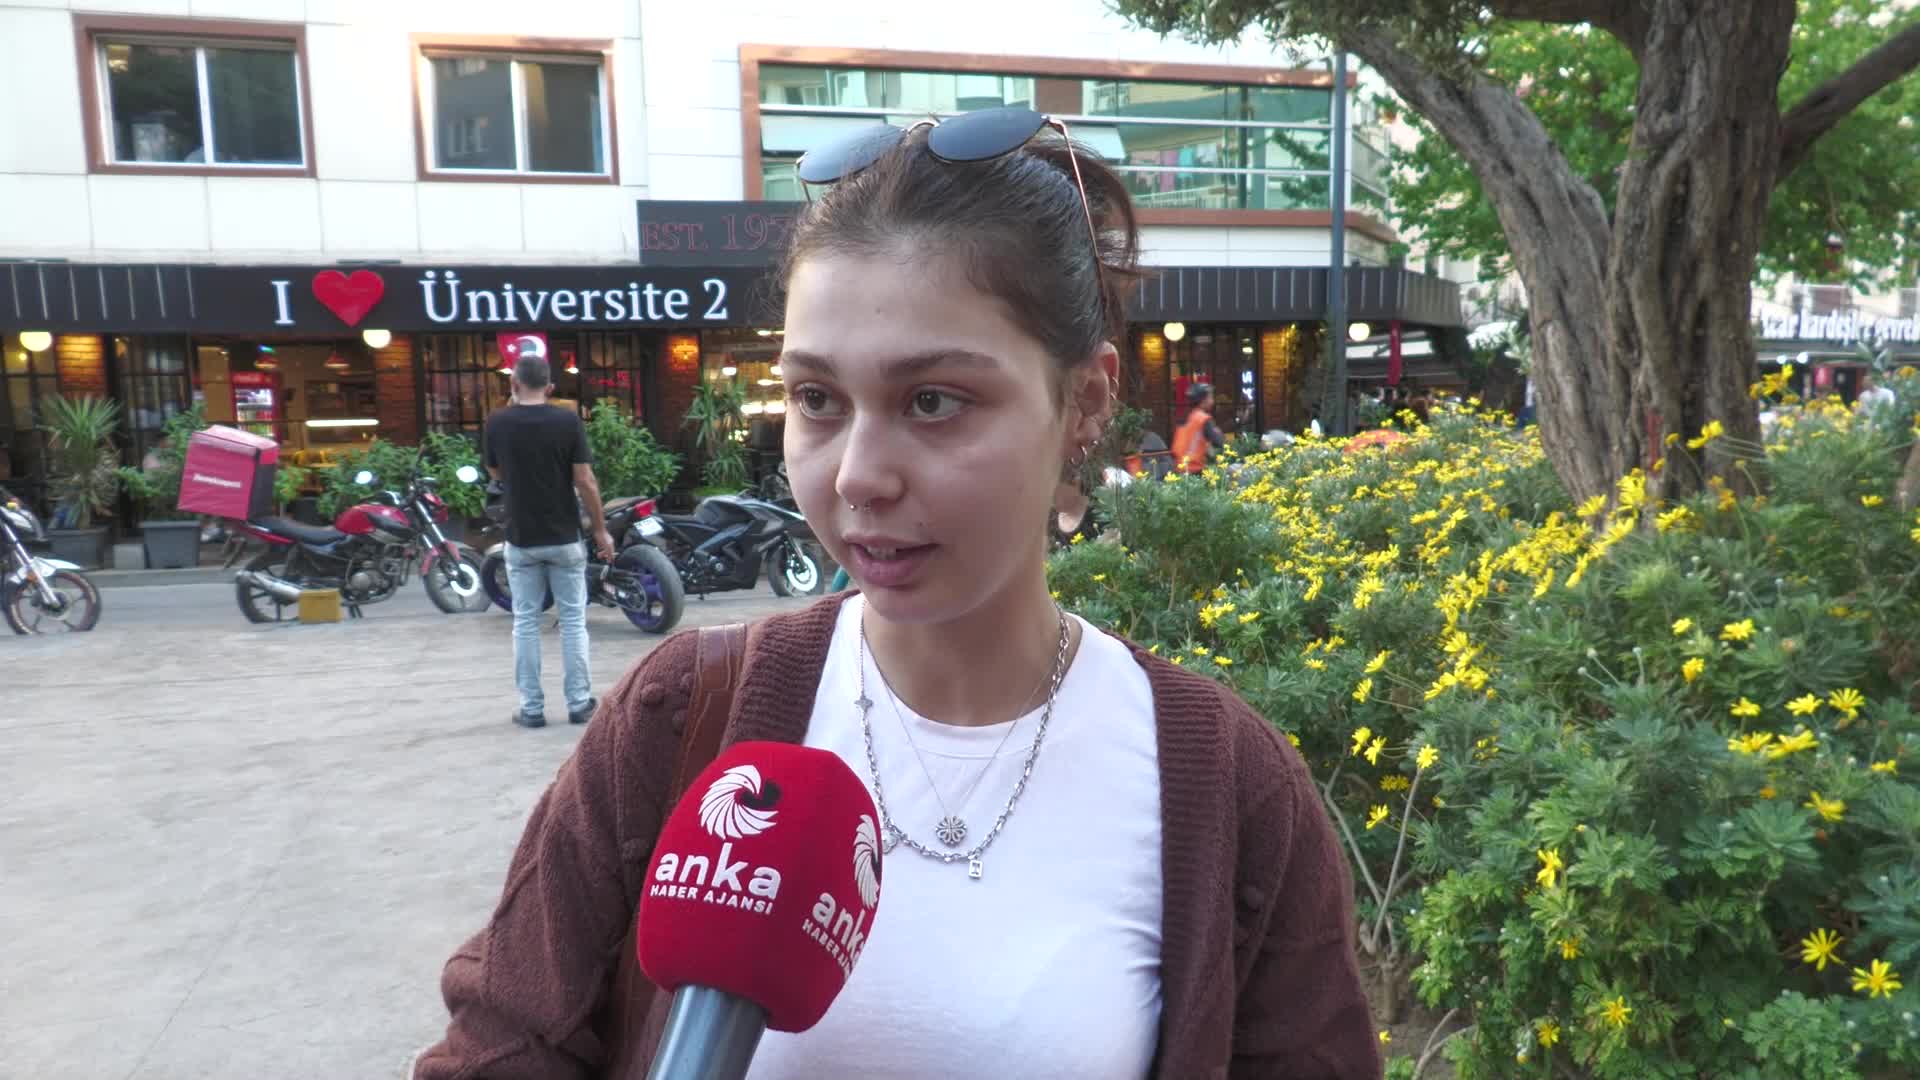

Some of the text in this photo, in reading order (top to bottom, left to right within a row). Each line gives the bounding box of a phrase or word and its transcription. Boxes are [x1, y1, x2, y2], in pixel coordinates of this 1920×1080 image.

[641, 213, 797, 251] EST. 197
[270, 270, 728, 325] I Üniversite 2
[655, 842, 782, 900] anka
[650, 884, 774, 915] HABER AJANSI
[802, 918, 841, 958] HABER
